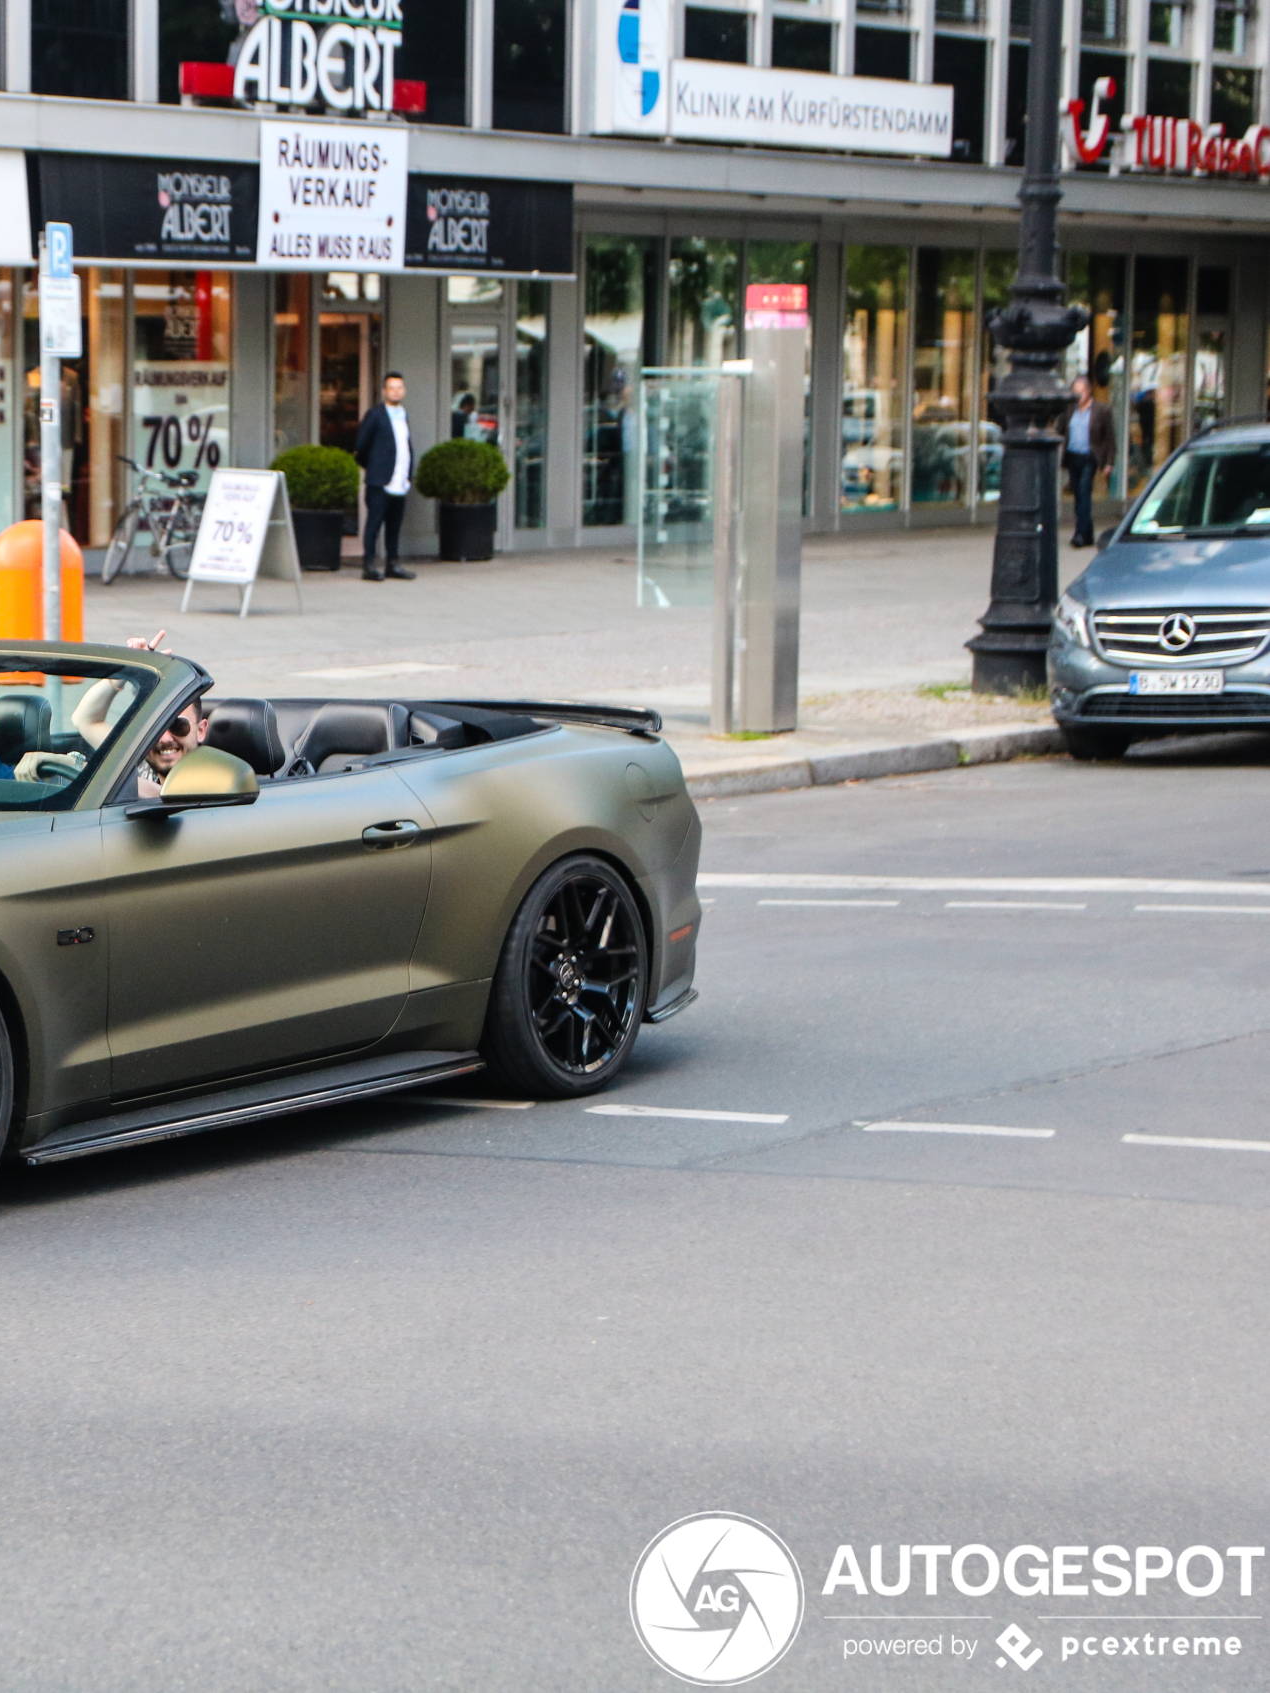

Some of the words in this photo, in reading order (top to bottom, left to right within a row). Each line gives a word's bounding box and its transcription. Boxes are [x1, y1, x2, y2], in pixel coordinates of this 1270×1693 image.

[233, 15, 402, 111] ALBERT
[676, 81, 740, 118] KLINIK
[745, 97, 774, 121] AM
[781, 90, 948, 136] KURFÜRSTENDAMM
[278, 133, 388, 172] RÄUMUNGS-
[1130, 114, 1177, 169] TUI
[290, 176, 376, 208] VERKAUF
[161, 203, 232, 241] ALBERT
[428, 217, 490, 253] ALBERT
[270, 233, 311, 258] ALLES
[318, 235, 351, 260] MUSS
[357, 236, 391, 261] RAUS
